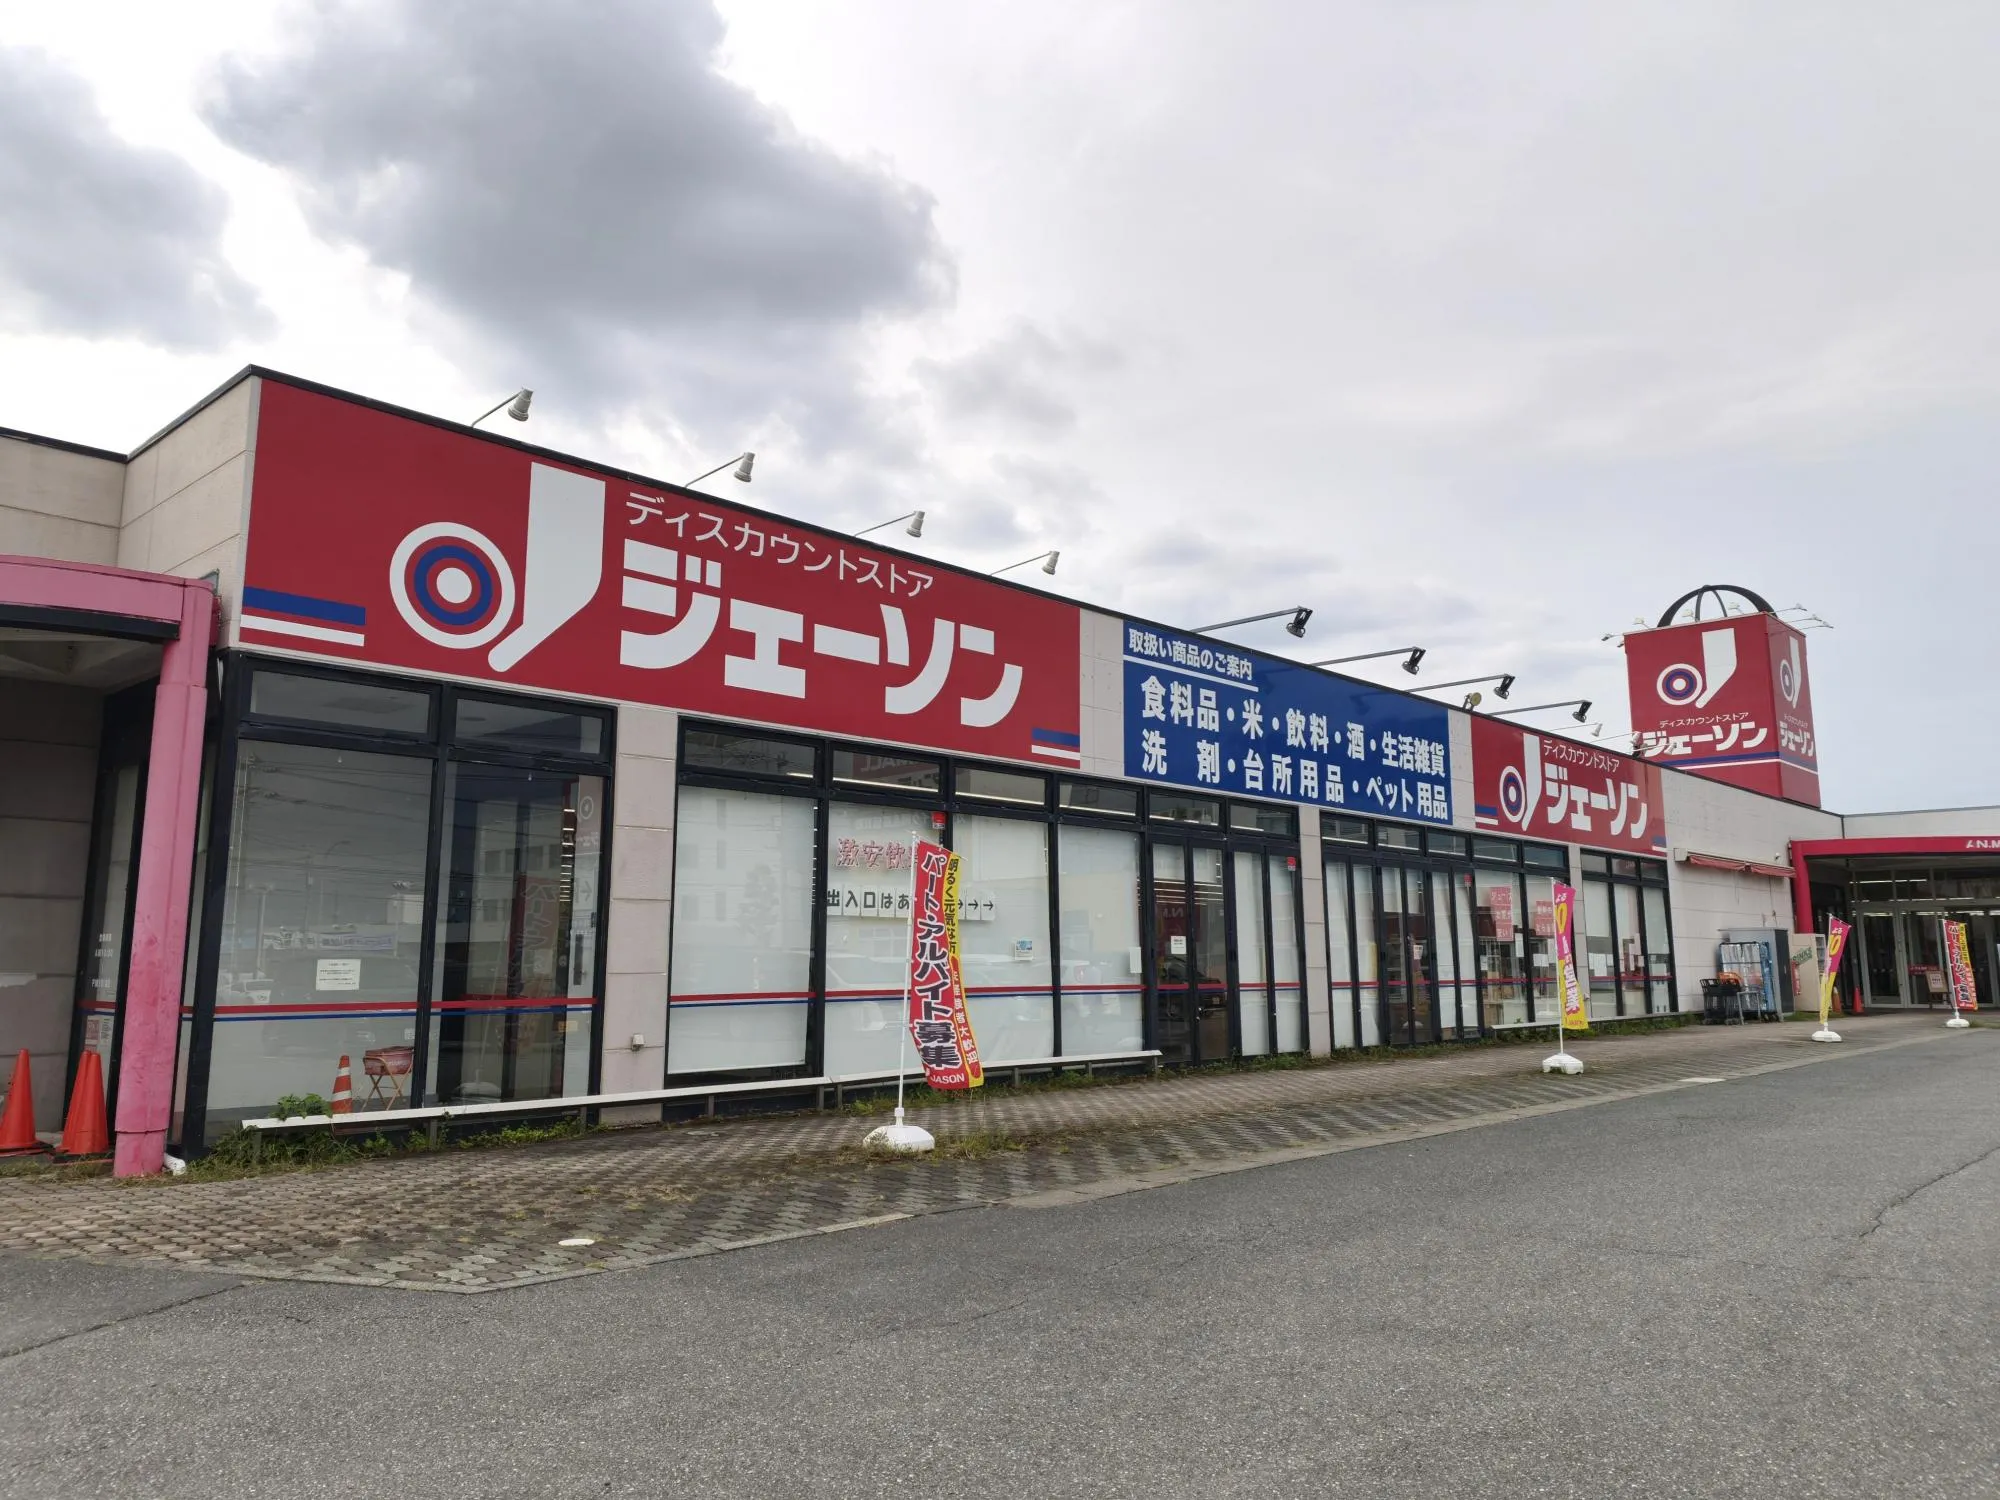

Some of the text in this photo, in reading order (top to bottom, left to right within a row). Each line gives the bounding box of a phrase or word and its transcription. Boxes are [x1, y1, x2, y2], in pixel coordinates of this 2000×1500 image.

[626, 491, 933, 597] ディスカウントストア
[619, 537, 1023, 728] ジェーソン
[1128, 628, 1253, 681] 取扱い商品のご案内
[1641, 721, 1768, 758] ジェーソン
[1659, 711, 1749, 729] ディスカウントストア
[1543, 739, 1620, 773] ディスカウントストア
[1545, 762, 1648, 839] ジェーソン
